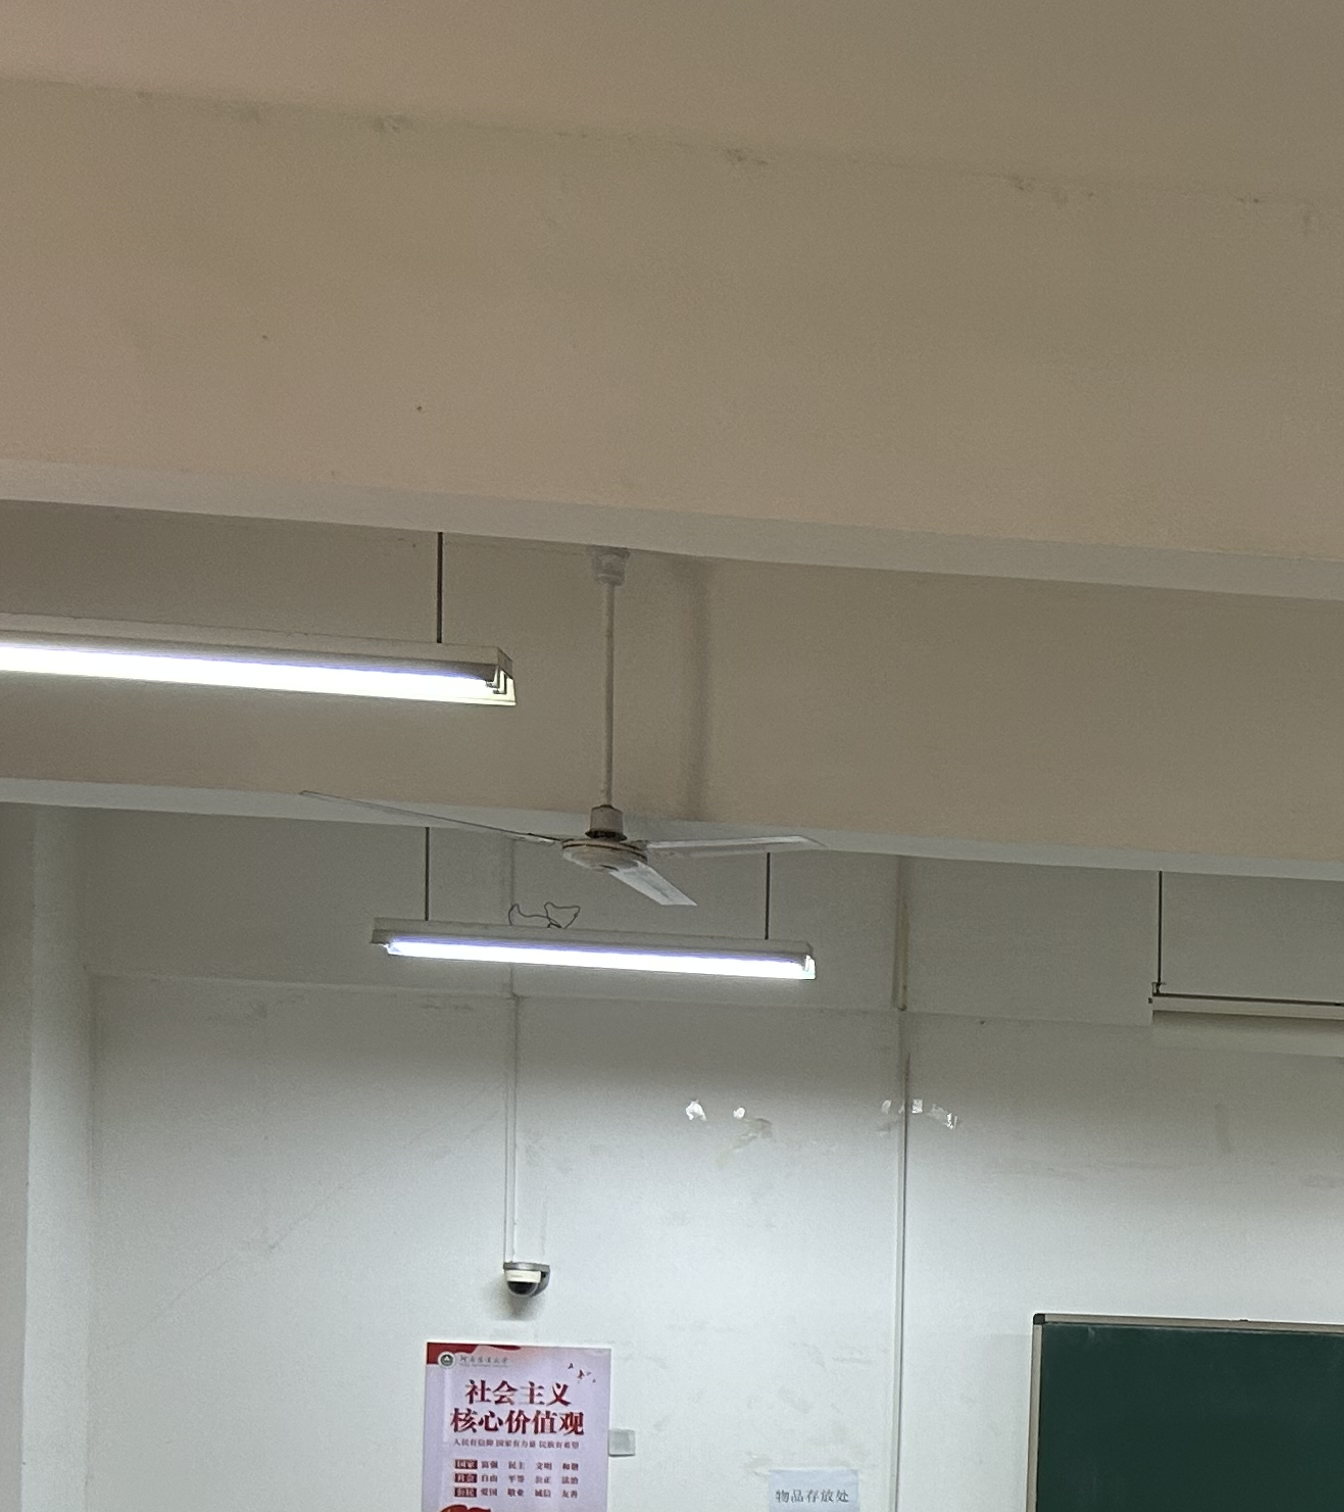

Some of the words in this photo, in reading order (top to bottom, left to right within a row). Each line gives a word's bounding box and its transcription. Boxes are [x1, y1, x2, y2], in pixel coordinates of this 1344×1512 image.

[465, 1379, 572, 1406] 社会主义
[450, 1408, 584, 1435] 核心价值观
[536, 1462, 552, 1470] 文明
[481, 1474, 498, 1483] 自由
[481, 1488, 498, 1497] 爱国
[775, 1489, 850, 1504] 物品存放处
